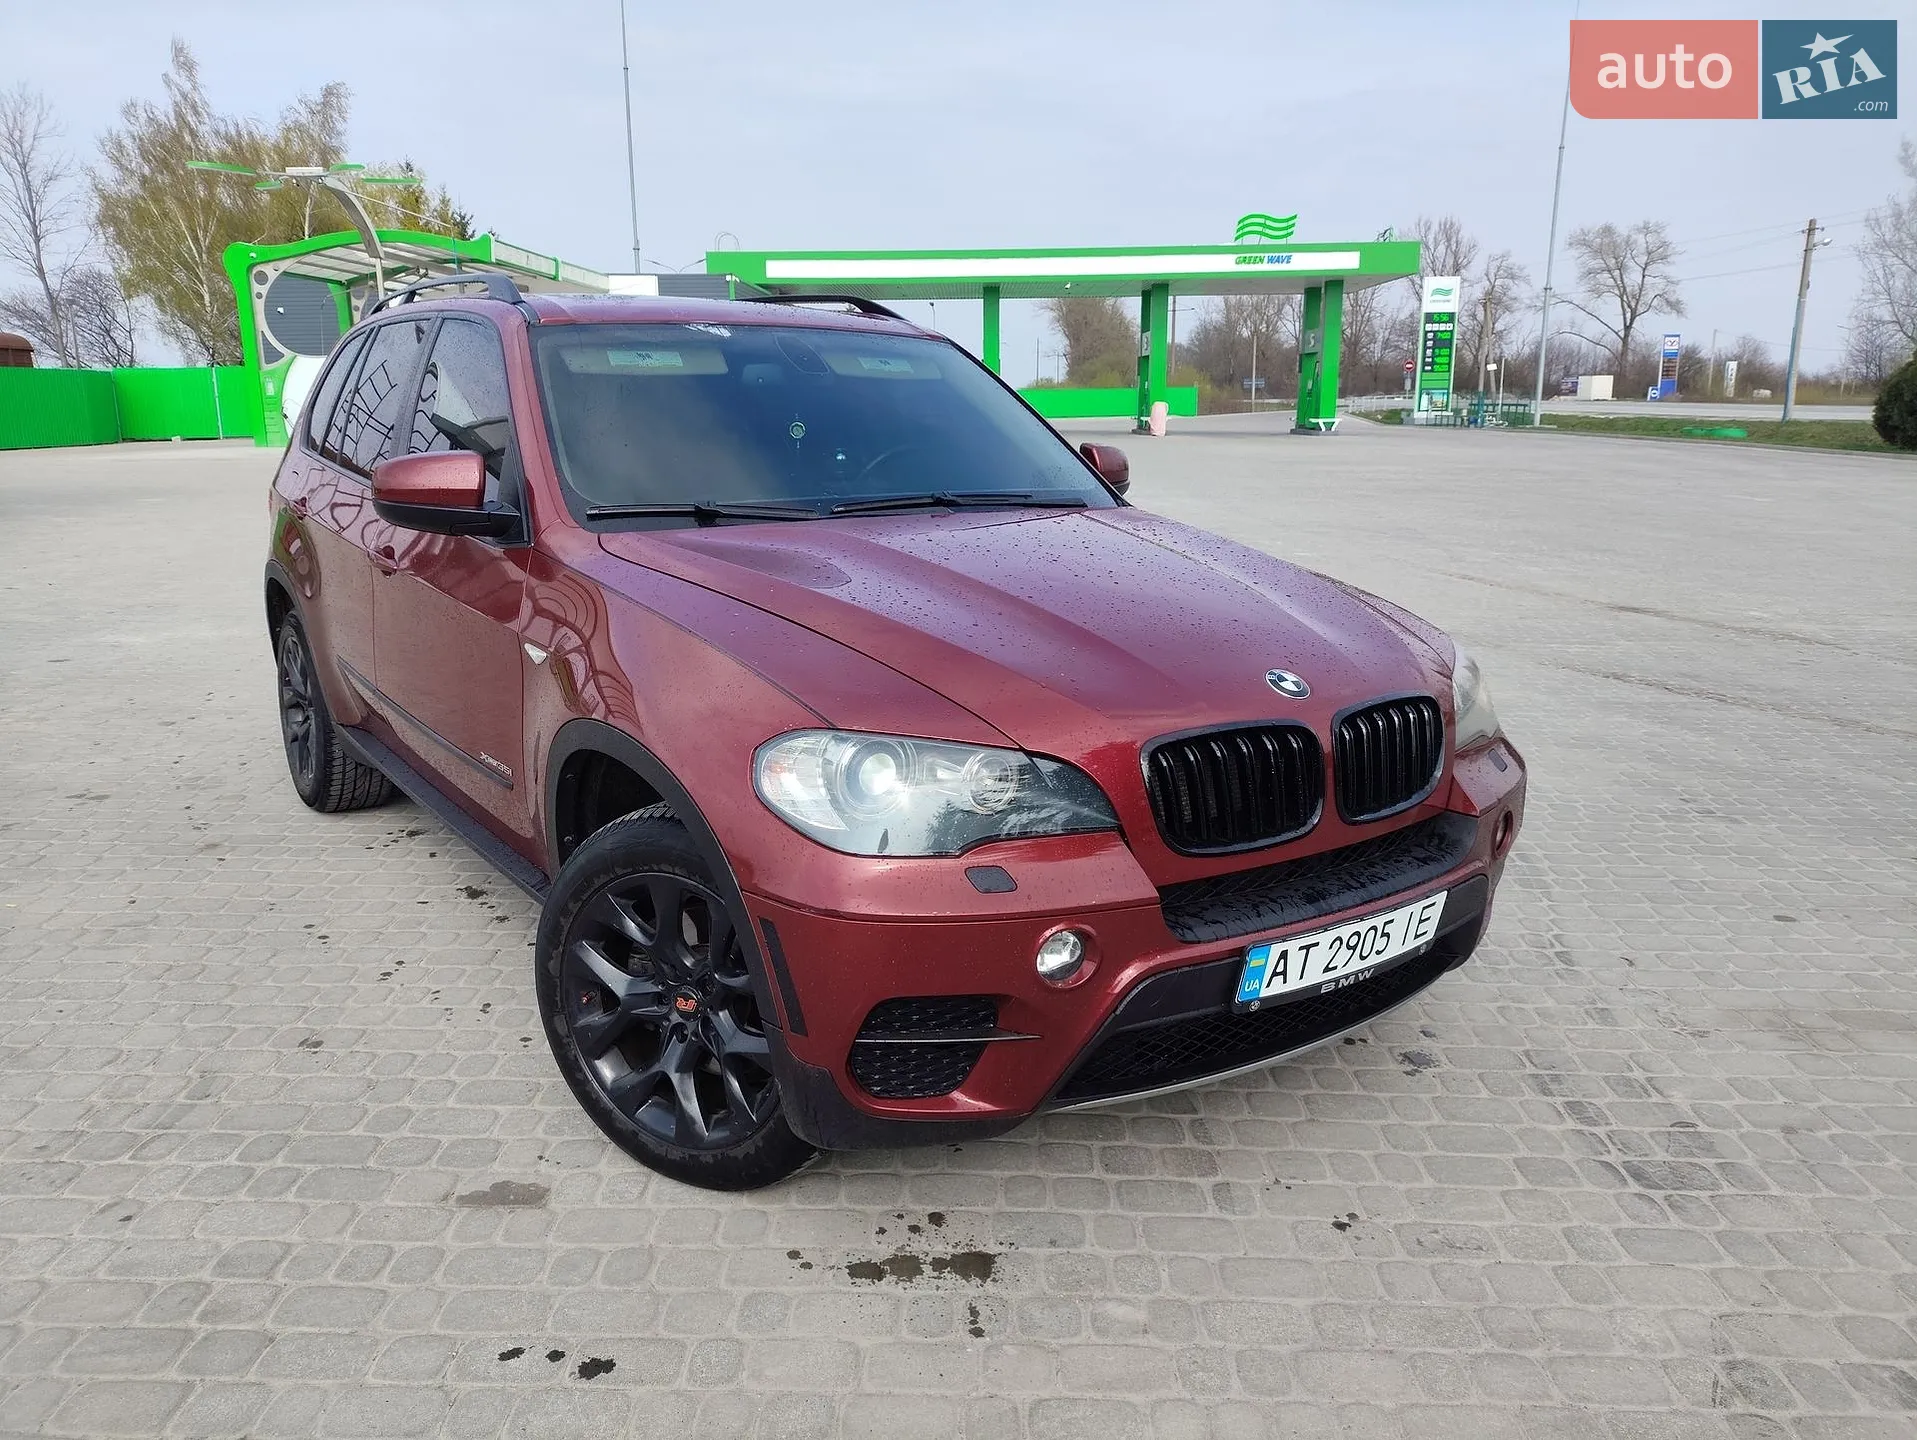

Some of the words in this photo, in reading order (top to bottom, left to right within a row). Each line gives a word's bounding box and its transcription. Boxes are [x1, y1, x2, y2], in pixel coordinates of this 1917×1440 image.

[1235, 255, 1265, 265] GREEN
[1267, 254, 1293, 265] WAVE
[1265, 941, 1320, 989] AT
[1321, 918, 1395, 974] 2905
[1401, 901, 1437, 947] IE
[1244, 979, 1260, 992] UA
[1320, 968, 1375, 994] BMW
